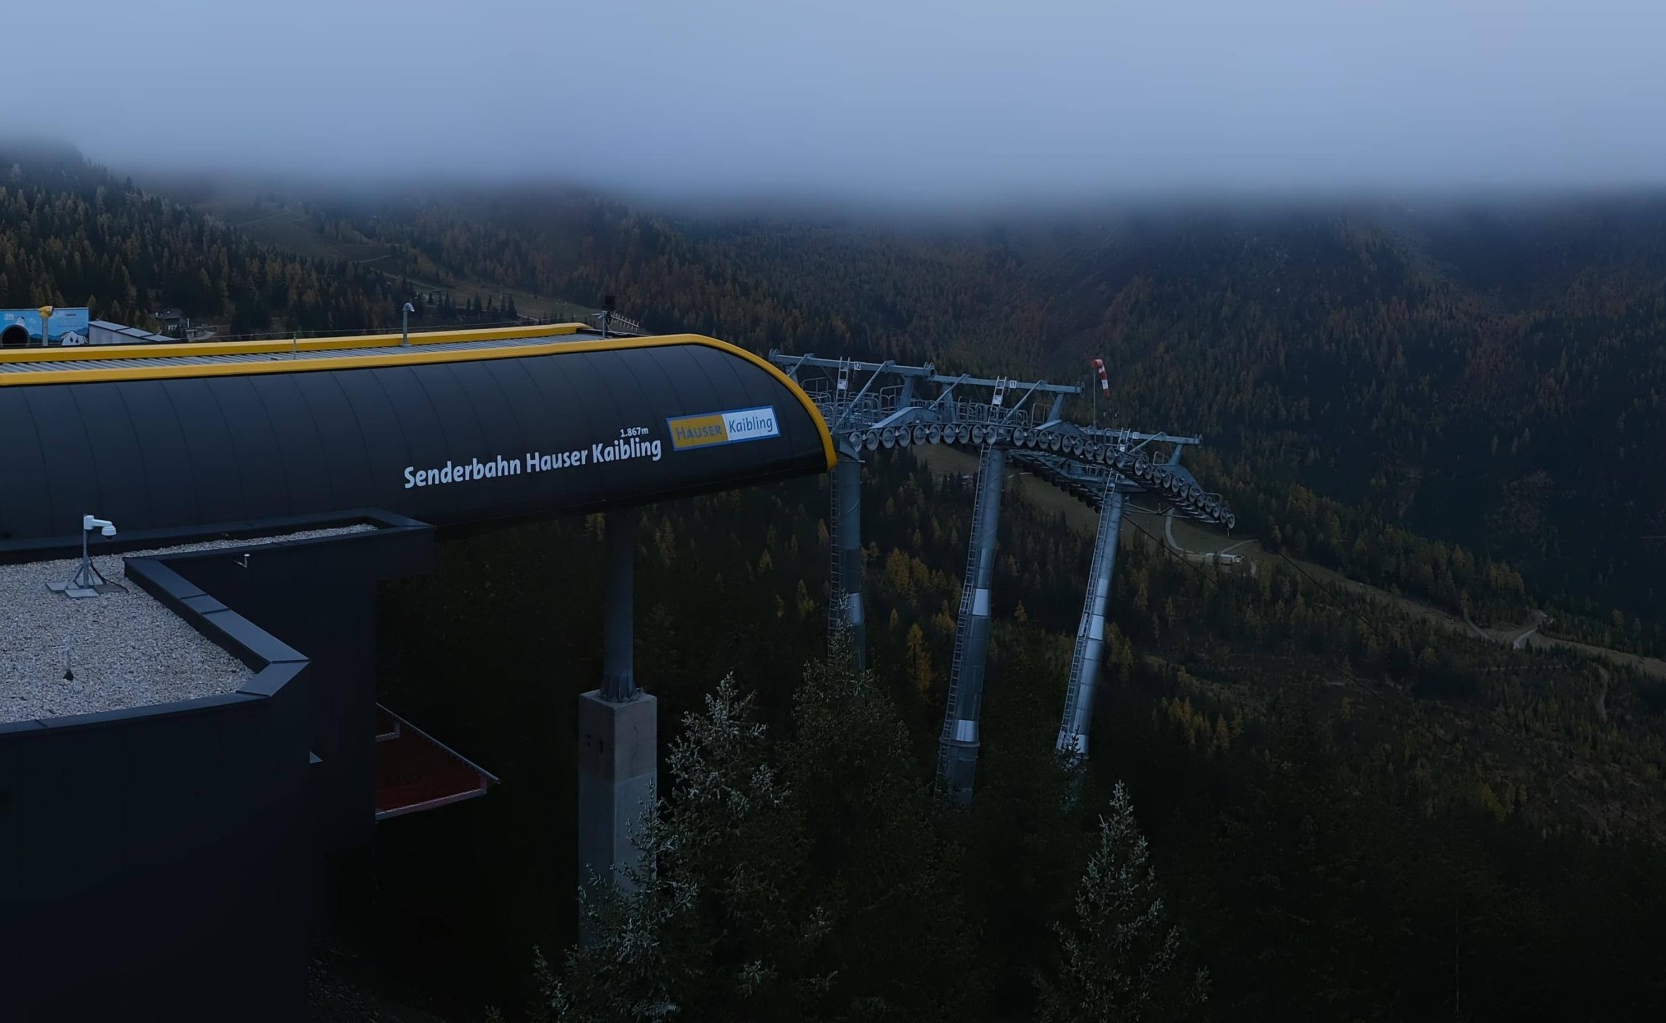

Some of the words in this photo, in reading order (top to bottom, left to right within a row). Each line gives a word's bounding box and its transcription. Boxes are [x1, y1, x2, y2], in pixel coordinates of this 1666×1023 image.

[620, 427, 649, 438] 1.867m
[675, 425, 723, 441] HAUSER
[729, 416, 773, 433] Kaibling
[404, 454, 521, 489] Senderbahn
[526, 449, 589, 473] Hauser
[592, 437, 662, 463] Kaibling
